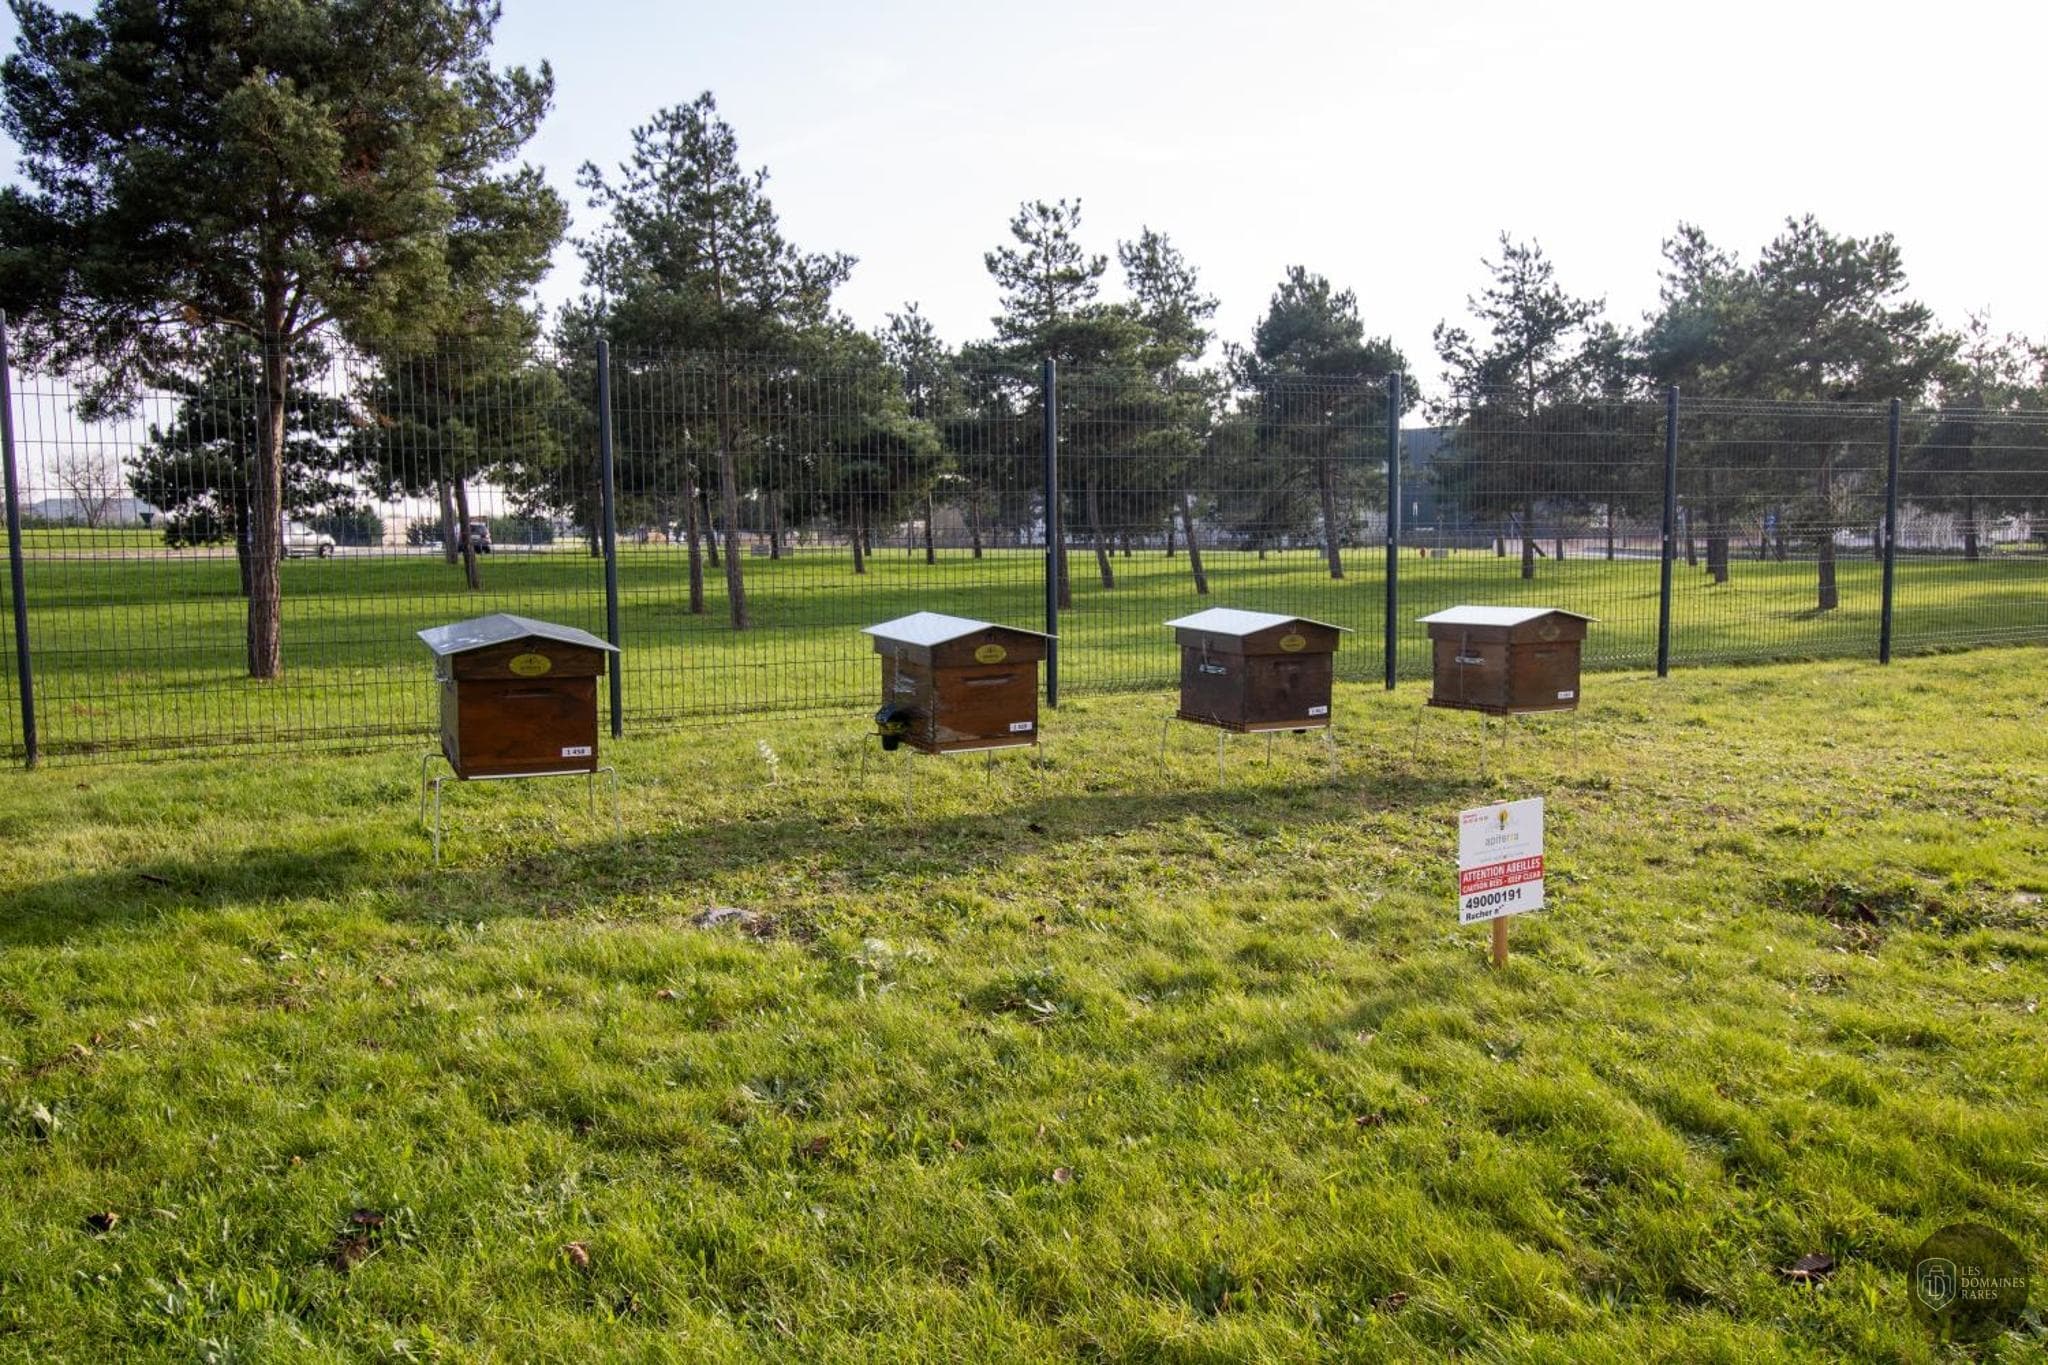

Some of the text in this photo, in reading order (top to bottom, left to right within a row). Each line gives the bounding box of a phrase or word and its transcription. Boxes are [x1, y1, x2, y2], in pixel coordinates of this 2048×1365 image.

[1463, 858, 1541, 883] ATTENTION ABEILLES
[1466, 888, 1521, 909] 49000191
[1466, 909, 1492, 921] Rucher
